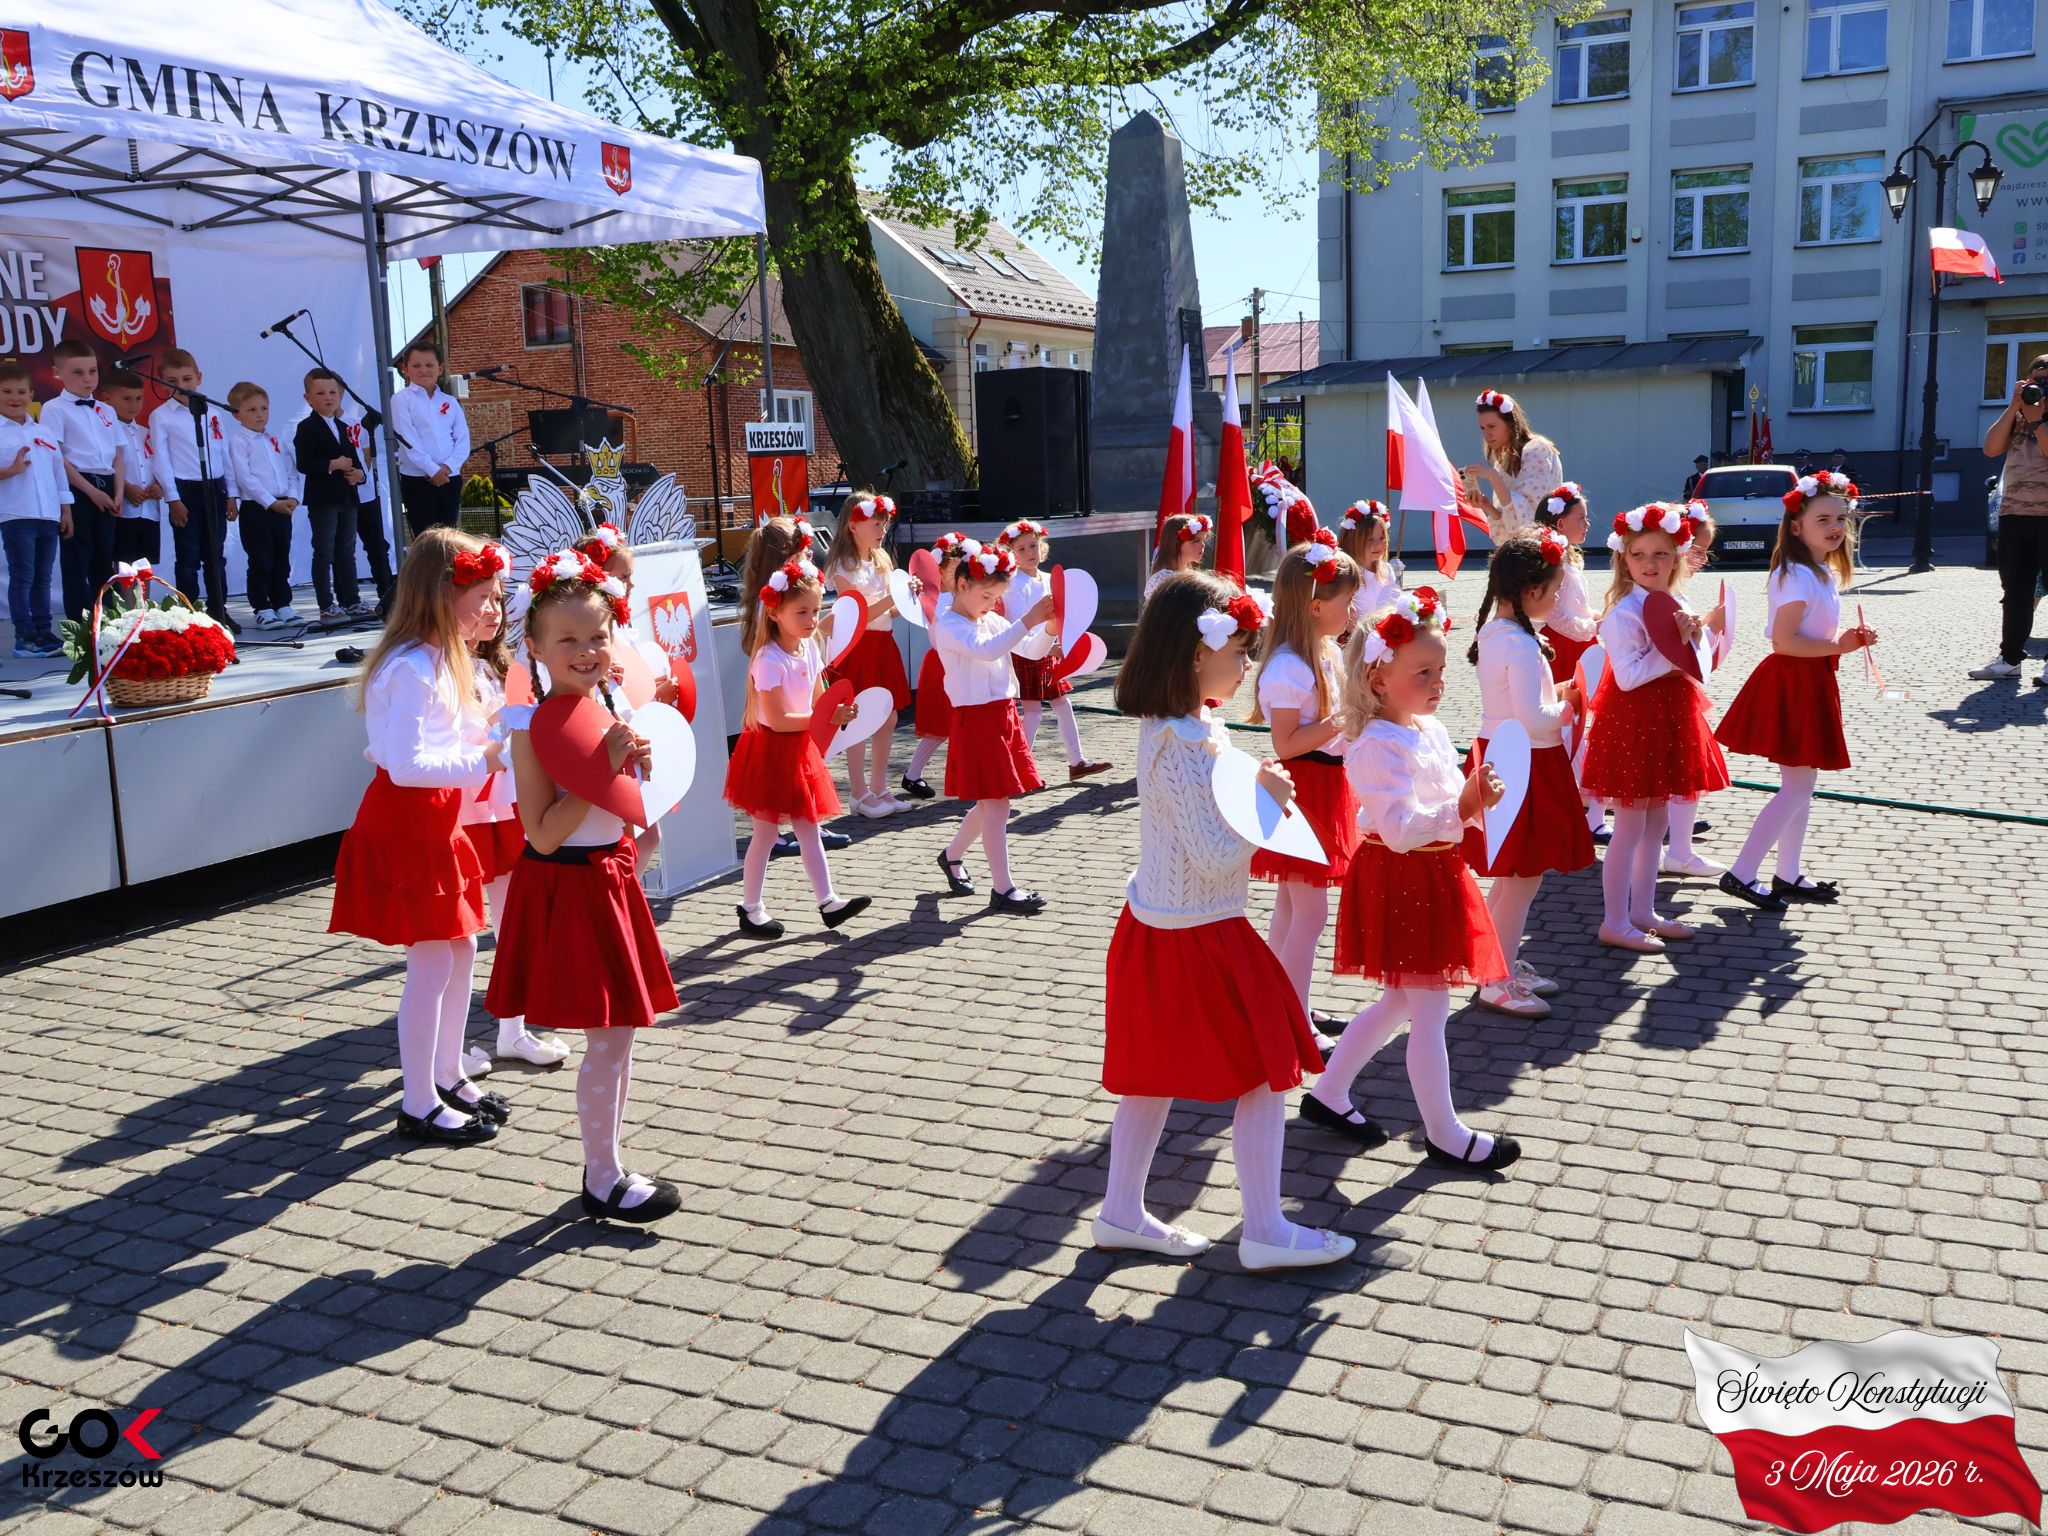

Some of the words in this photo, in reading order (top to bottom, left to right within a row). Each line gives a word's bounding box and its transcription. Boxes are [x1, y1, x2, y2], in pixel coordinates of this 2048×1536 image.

[71, 51, 291, 134] GMINA
[315, 92, 577, 183] KRZESZÓW
[749, 426, 804, 448] KRZESZÓW
